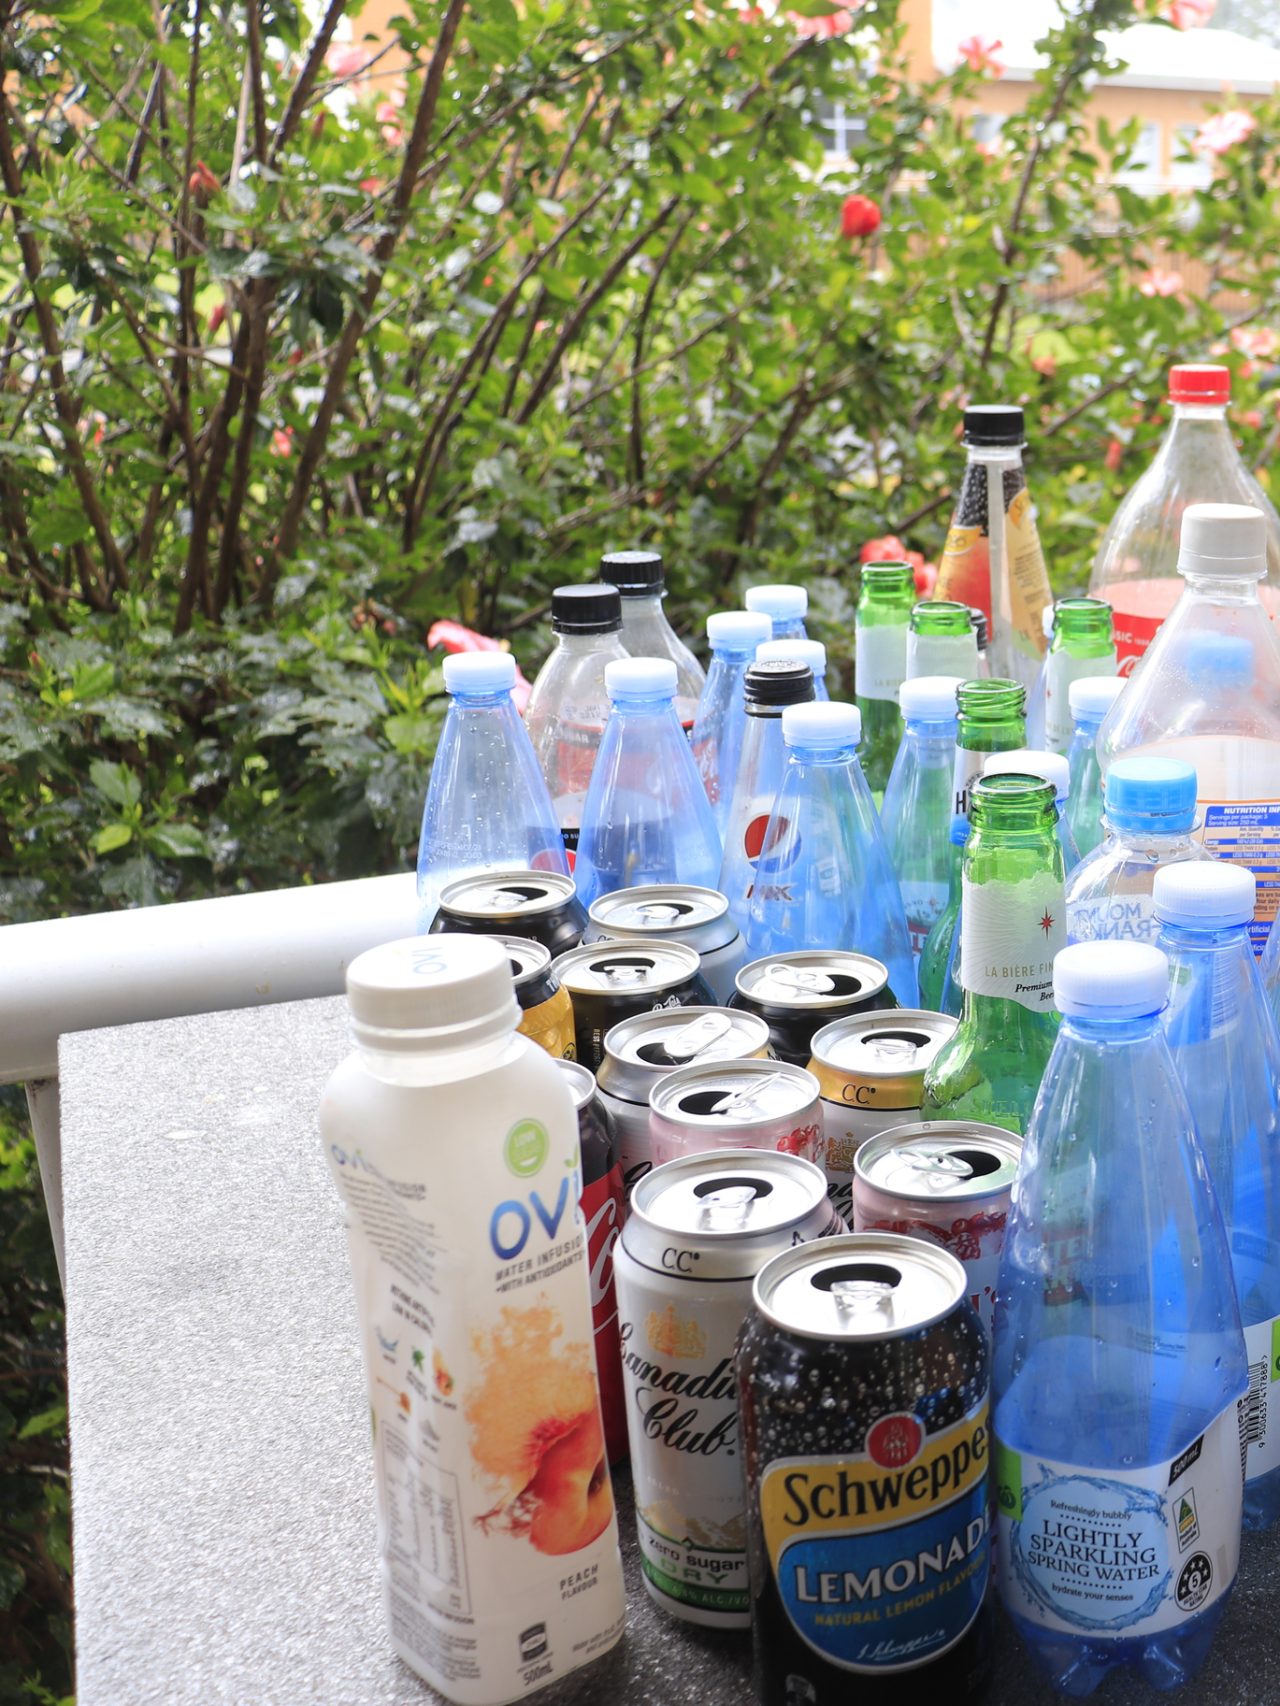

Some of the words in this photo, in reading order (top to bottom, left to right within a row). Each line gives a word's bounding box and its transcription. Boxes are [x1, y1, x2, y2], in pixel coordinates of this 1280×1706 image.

[1224, 807, 1268, 815] NUTRITION
[985, 965, 998, 977] LA
[1002, 962, 1035, 978] BIÈRE
[1039, 960, 1054, 974] FIN
[1015, 980, 1053, 993] Premium
[495, 1258, 533, 1283] WATER
[1050, 1499, 1102, 1518] Refreshingly
[1103, 1511, 1133, 1521] bubbly
[1043, 1520, 1144, 1549] LIGHTLY
[650, 1538, 680, 1560] zero
[686, 1555, 745, 1573] sugar
[1031, 1534, 1156, 1567] SPARKLING
[560, 1563, 598, 1591] PEACH
[661, 1557, 729, 1584] DRY
[1028, 1551, 1090, 1578] SPRING
[1094, 1564, 1160, 1582] WATER
[561, 1576, 598, 1600] FLAVOUR
[815, 1605, 881, 1626] NATURAL
[886, 1590, 935, 1618] LEMON
[939, 1550, 986, 1596] FLAVOU
[1051, 1583, 1082, 1597] hydrate
[1084, 1592, 1105, 1600] your
[1190, 1576, 1198, 1588] 5
